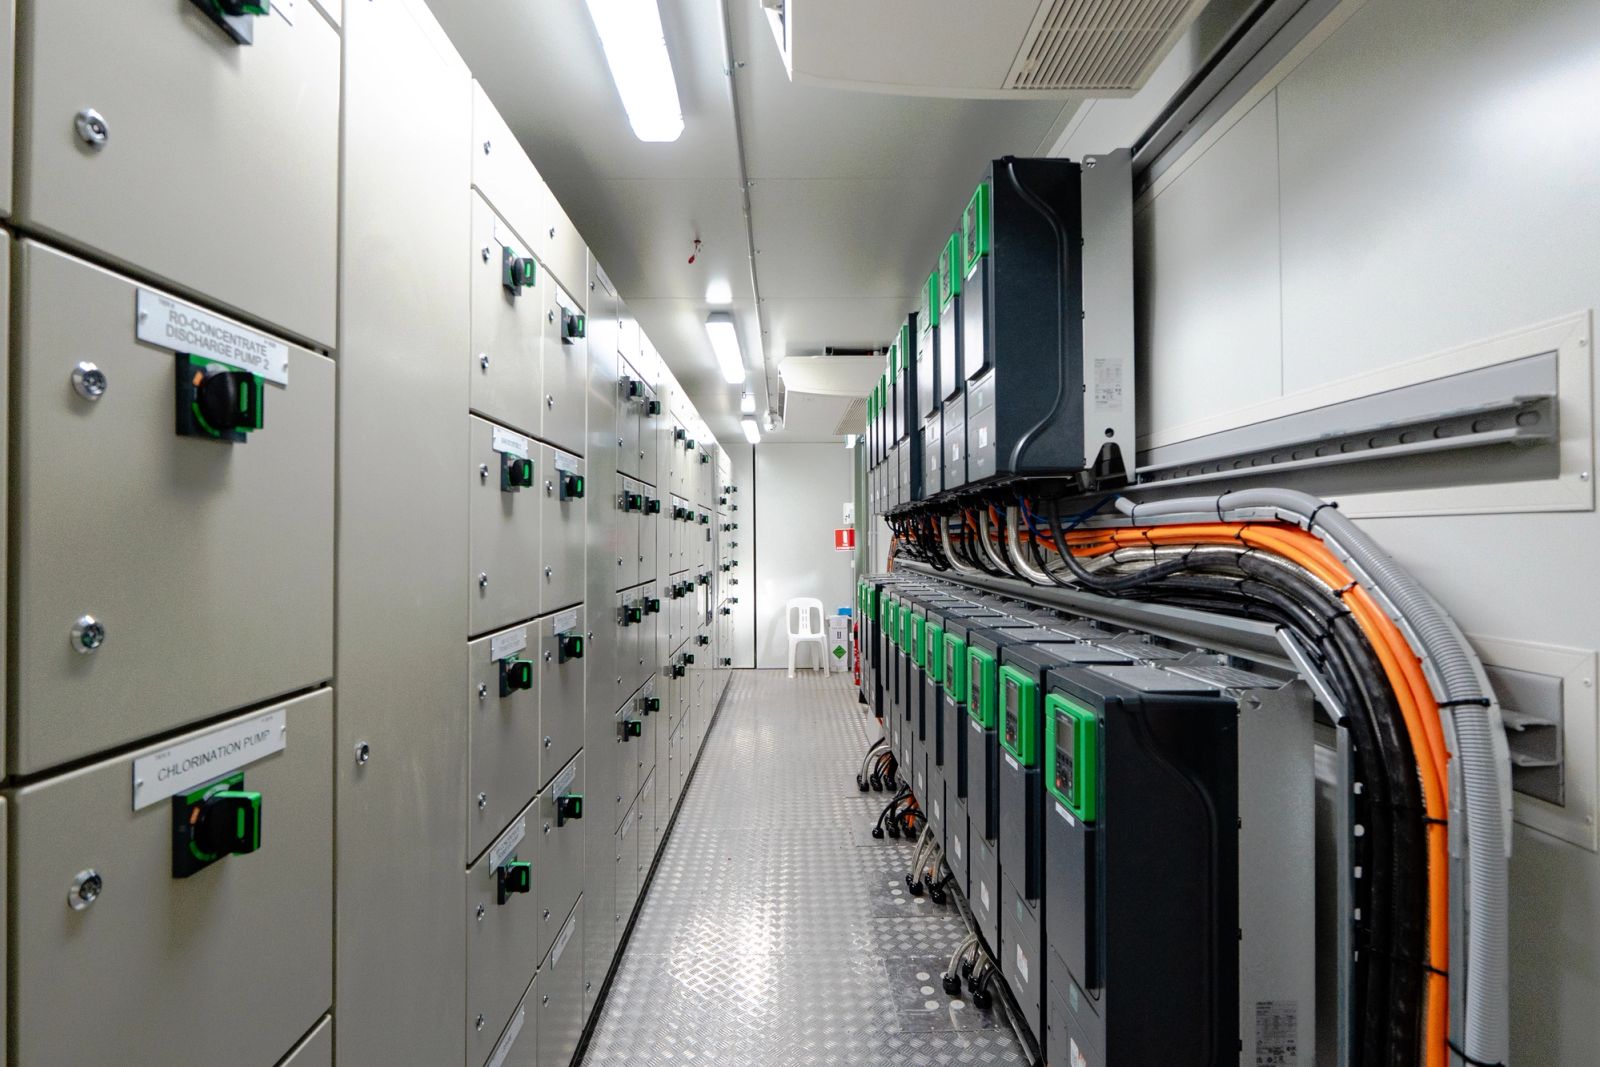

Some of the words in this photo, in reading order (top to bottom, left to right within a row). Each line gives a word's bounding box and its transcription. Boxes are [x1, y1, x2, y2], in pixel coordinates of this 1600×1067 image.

[166, 324, 232, 357] DISCHARGE
[234, 349, 262, 367] PUMP
[263, 359, 270, 370] 2
[169, 310, 267, 357] RO-CONCENTRATE
[157, 740, 242, 782] CHLORINATION
[243, 729, 270, 749] PUMP
